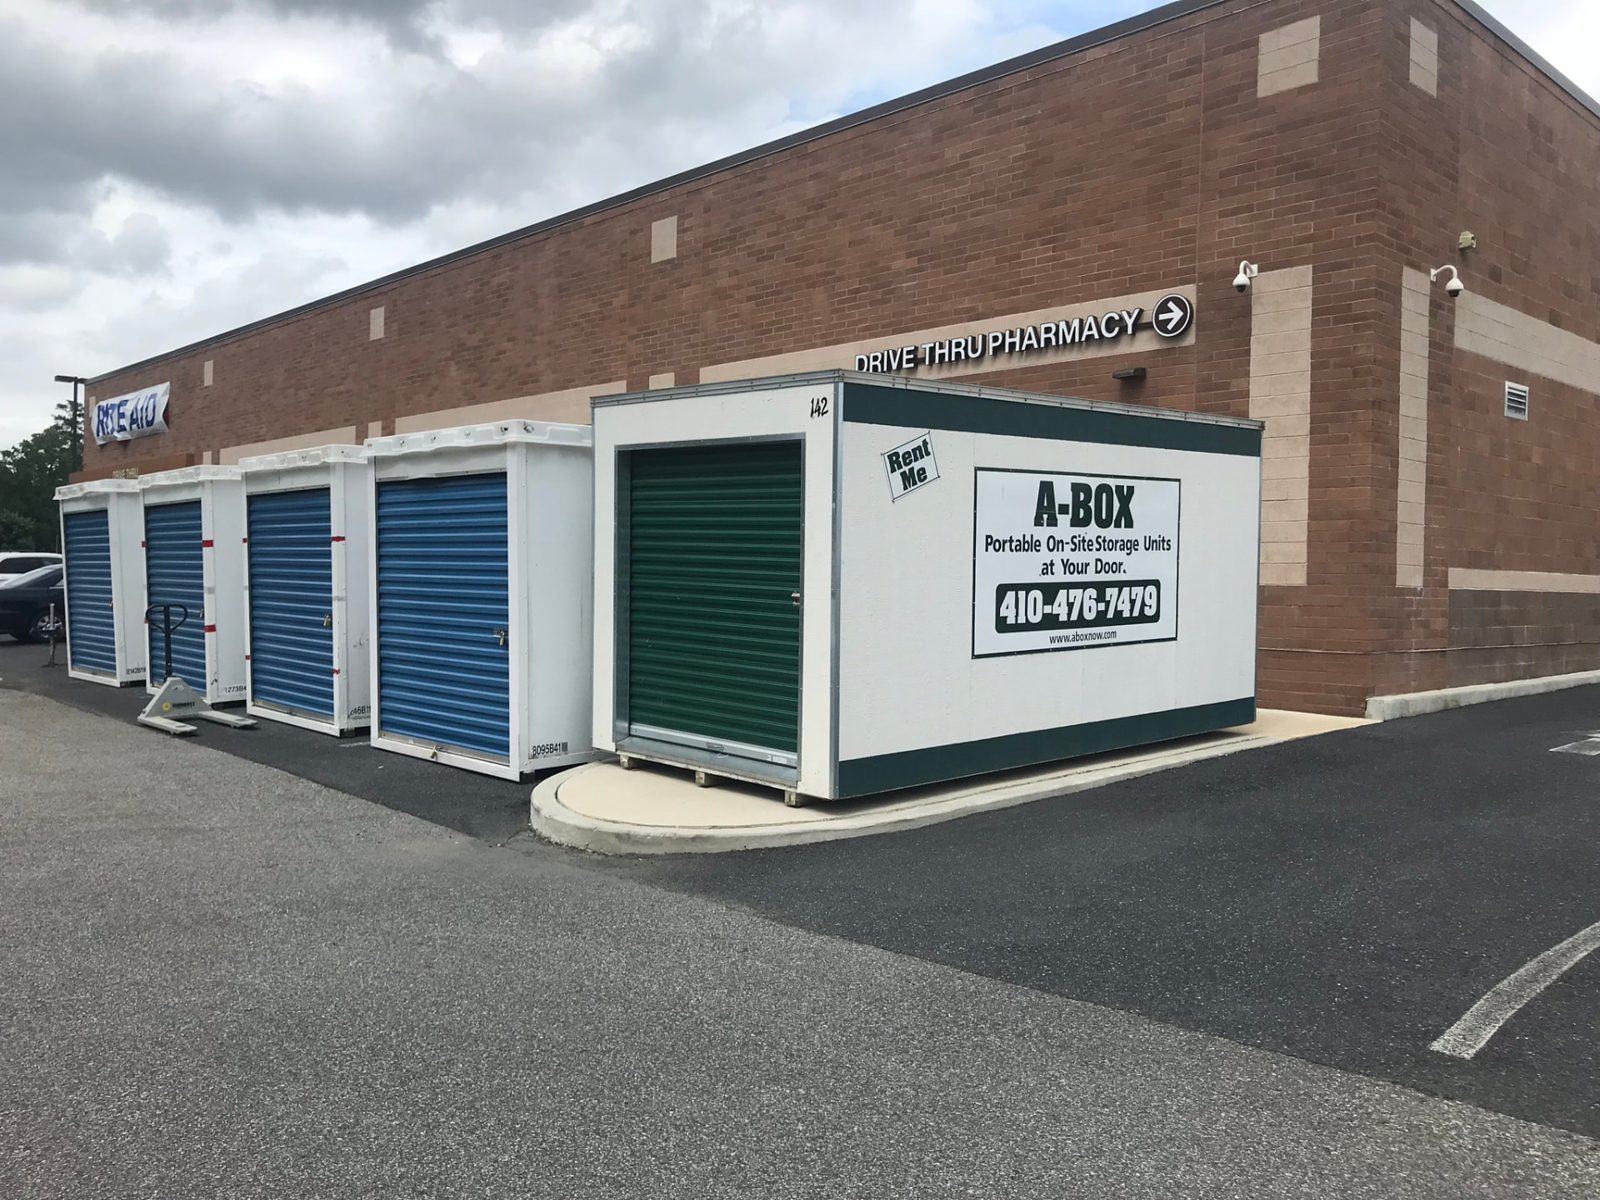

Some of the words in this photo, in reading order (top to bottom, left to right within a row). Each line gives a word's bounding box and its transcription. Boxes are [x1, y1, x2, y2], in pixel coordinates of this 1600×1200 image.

[855, 345, 915, 373] DRIVE
[922, 333, 984, 366] THRU
[988, 307, 1143, 356] PHARMACY
[129, 392, 158, 431] AID
[810, 396, 829, 418] 142
[887, 438, 931, 474] Rent
[900, 466, 928, 491] Me
[1033, 480, 1135, 529] A-BOX
[985, 534, 1042, 553] Portable
[1046, 534, 1094, 553] On-Site
[1095, 535, 1139, 556] Storage
[1143, 535, 1172, 552] Units
[1041, 559, 1055, 576] at
[1060, 558, 1090, 575] Your
[1094, 558, 1127, 574] Door.
[999, 585, 1158, 625] 410-476-7479
[1049, 629, 1117, 645] www.aboxnow.com
[532, 743, 561, 757] 8095B41
